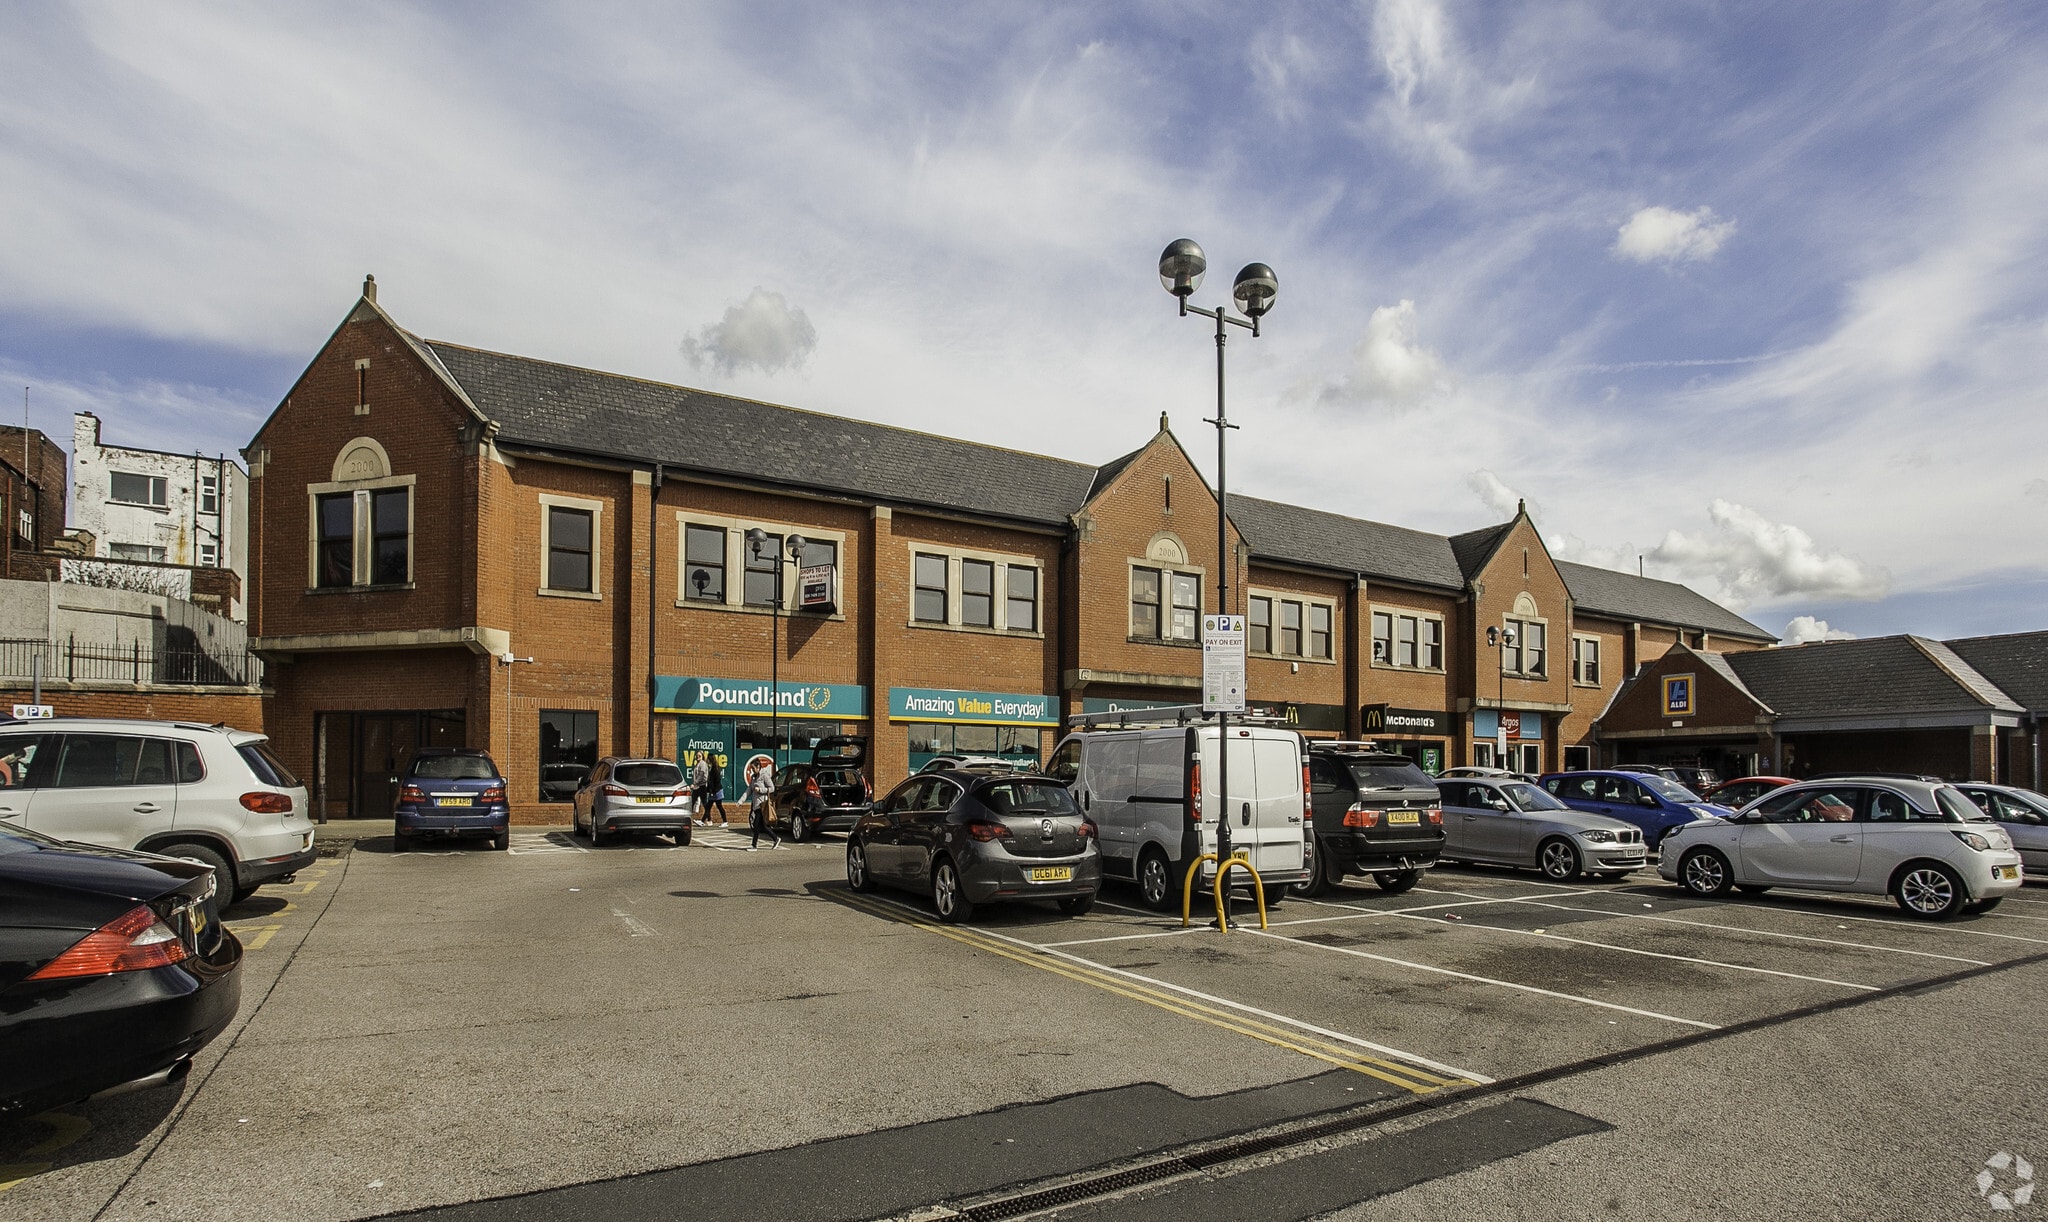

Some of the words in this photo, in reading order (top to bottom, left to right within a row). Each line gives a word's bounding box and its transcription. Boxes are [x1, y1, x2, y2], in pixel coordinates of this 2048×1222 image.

[351, 460, 374, 473] 2000
[1159, 547, 1176, 557] 2000
[1219, 617, 1229, 631] P
[699, 682, 805, 707] Poundland
[905, 694, 955, 715] Amazing
[957, 697, 992, 714] Value
[994, 699, 1044, 719] Everyday!
[1670, 700, 1687, 708] ALDI
[29, 707, 38, 716] P
[1386, 715, 1435, 728] McDonald's
[1501, 715, 1519, 729] Argos
[687, 738, 724, 752] Amazing
[1034, 869, 1052, 878] GC61
[1054, 868, 1068, 877] ARY
